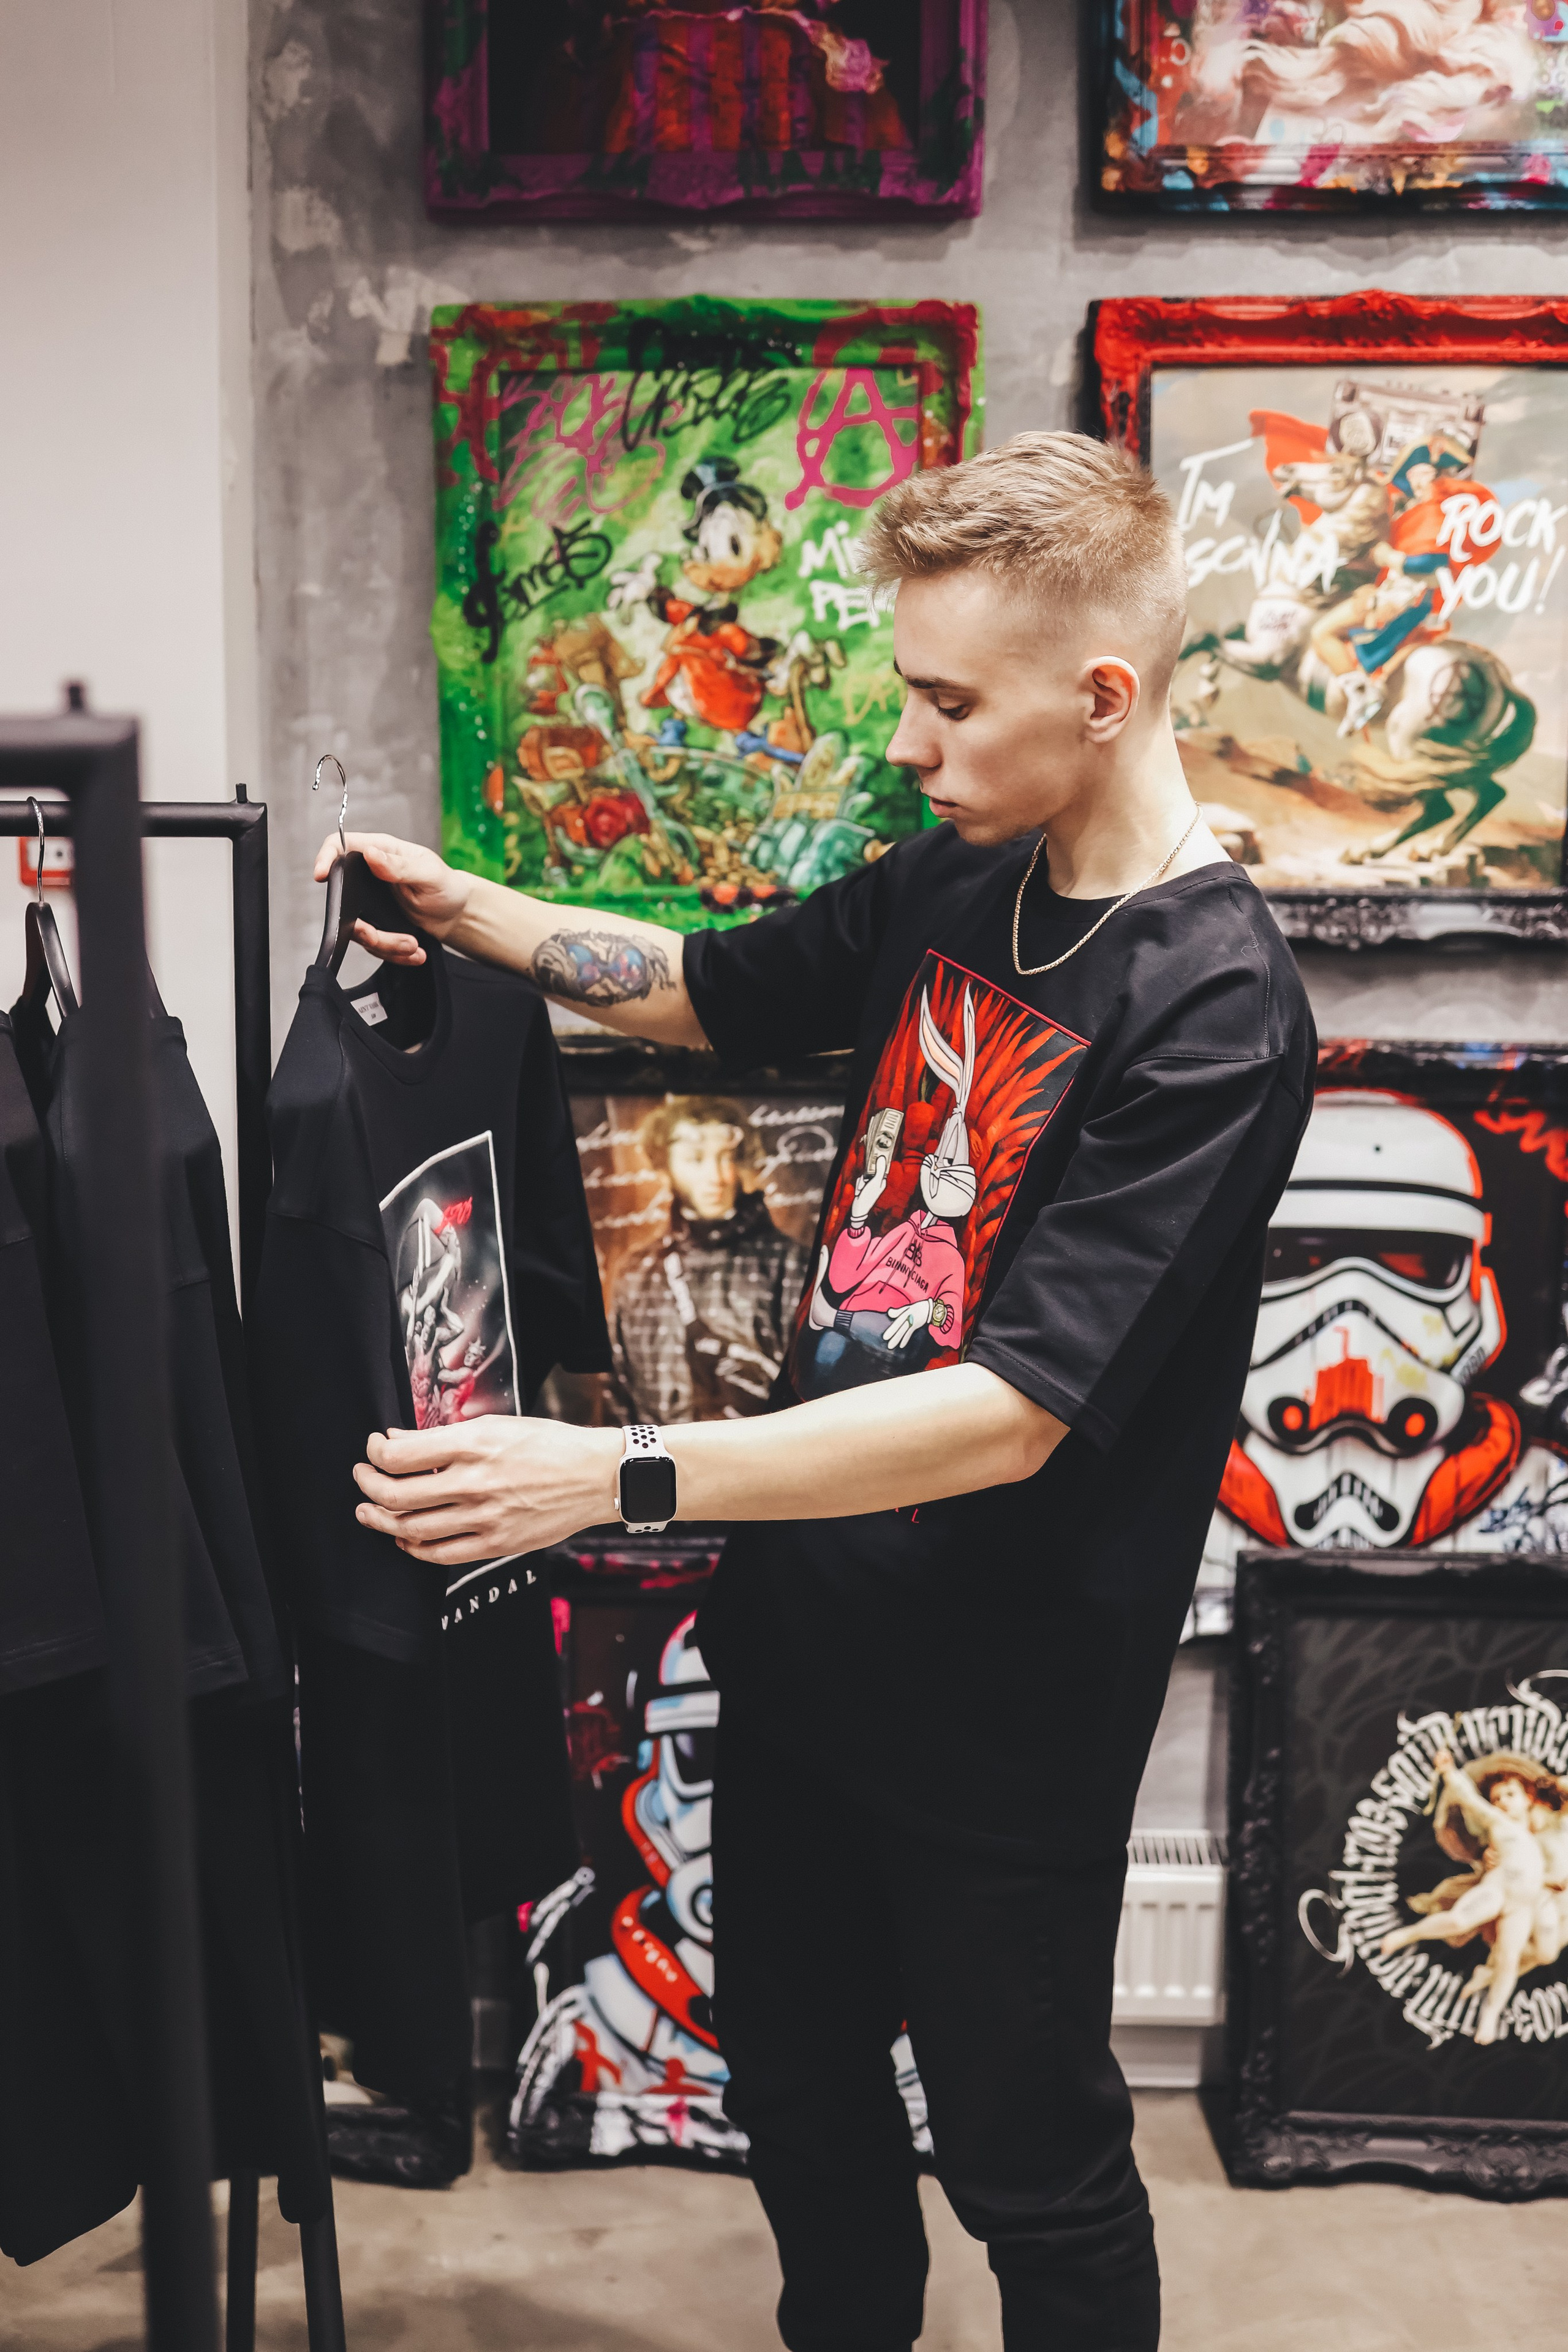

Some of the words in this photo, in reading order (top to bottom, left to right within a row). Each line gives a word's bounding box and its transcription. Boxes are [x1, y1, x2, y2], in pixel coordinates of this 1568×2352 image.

[1436, 492, 1568, 563] ROCK
[1435, 545, 1567, 624] YOU!
[442, 1569, 537, 1630] VANDAL
